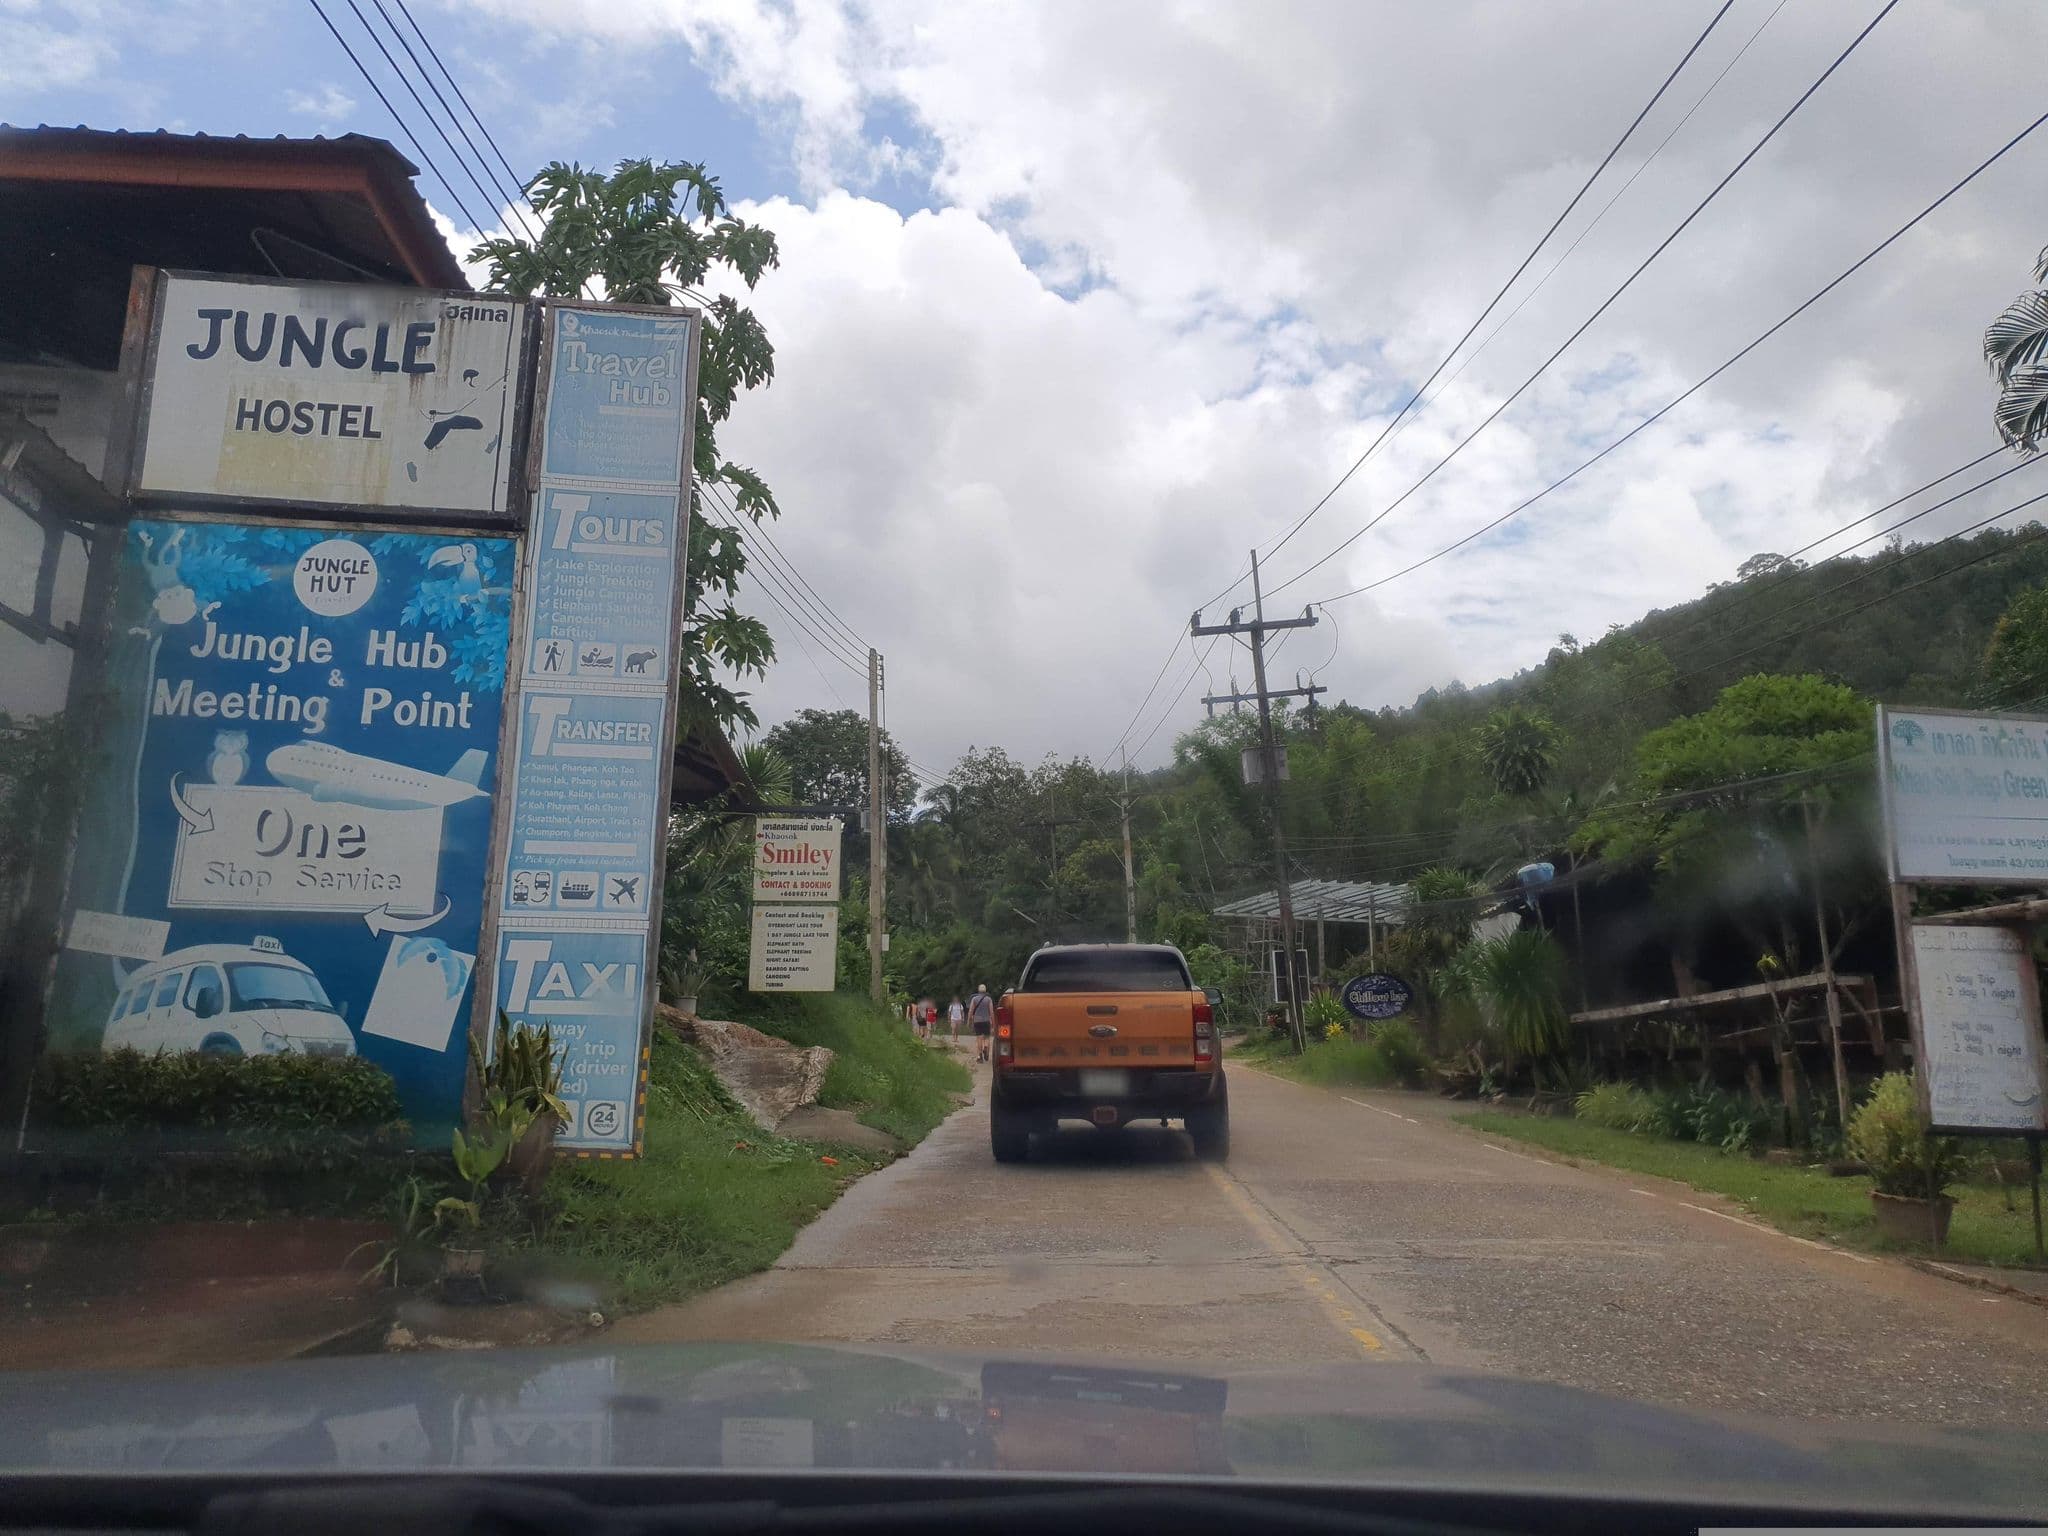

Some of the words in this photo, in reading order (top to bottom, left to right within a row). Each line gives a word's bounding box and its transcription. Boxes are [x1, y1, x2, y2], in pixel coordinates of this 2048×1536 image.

[186, 308, 437, 374] JUNGLE
[563, 341, 677, 379] Travel
[610, 379, 671, 406] Hub
[235, 398, 382, 439] HOSTEL
[551, 493, 665, 549] Tours
[302, 557, 370, 575] JUNGLE
[555, 557, 585, 570] Lake
[587, 560, 660, 577] Exploration
[310, 575, 356, 593] HUT
[554, 571, 597, 587] Jungle
[601, 575, 654, 590] Trekking
[553, 585, 596, 600] Jungle
[599, 588, 654, 603] Camping
[552, 598, 598, 613] Elephant
[550, 625, 597, 640] Rafting
[190, 622, 333, 674] Jungle
[365, 629, 447, 669] Hub
[327, 668, 345, 687] &
[152, 678, 330, 734] Meeting
[360, 687, 473, 729] Point
[528, 696, 652, 756] TRANSFER
[256, 806, 367, 860] One
[765, 831, 798, 840] Khaosok
[762, 841, 834, 871] Smiley
[203, 861, 272, 897] Stop
[296, 864, 402, 892] Service
[761, 880, 790, 888] CONTACT
[801, 881, 832, 889] BOOKING
[259, 936, 281, 951] taxi
[505, 939, 637, 1013] TAXI
[1349, 990, 1390, 1004] Chillout
[552, 1023, 587, 1040] way
[584, 1040, 616, 1059] trip
[569, 1060, 628, 1076] (driver
[594, 1111, 615, 1123] 24
